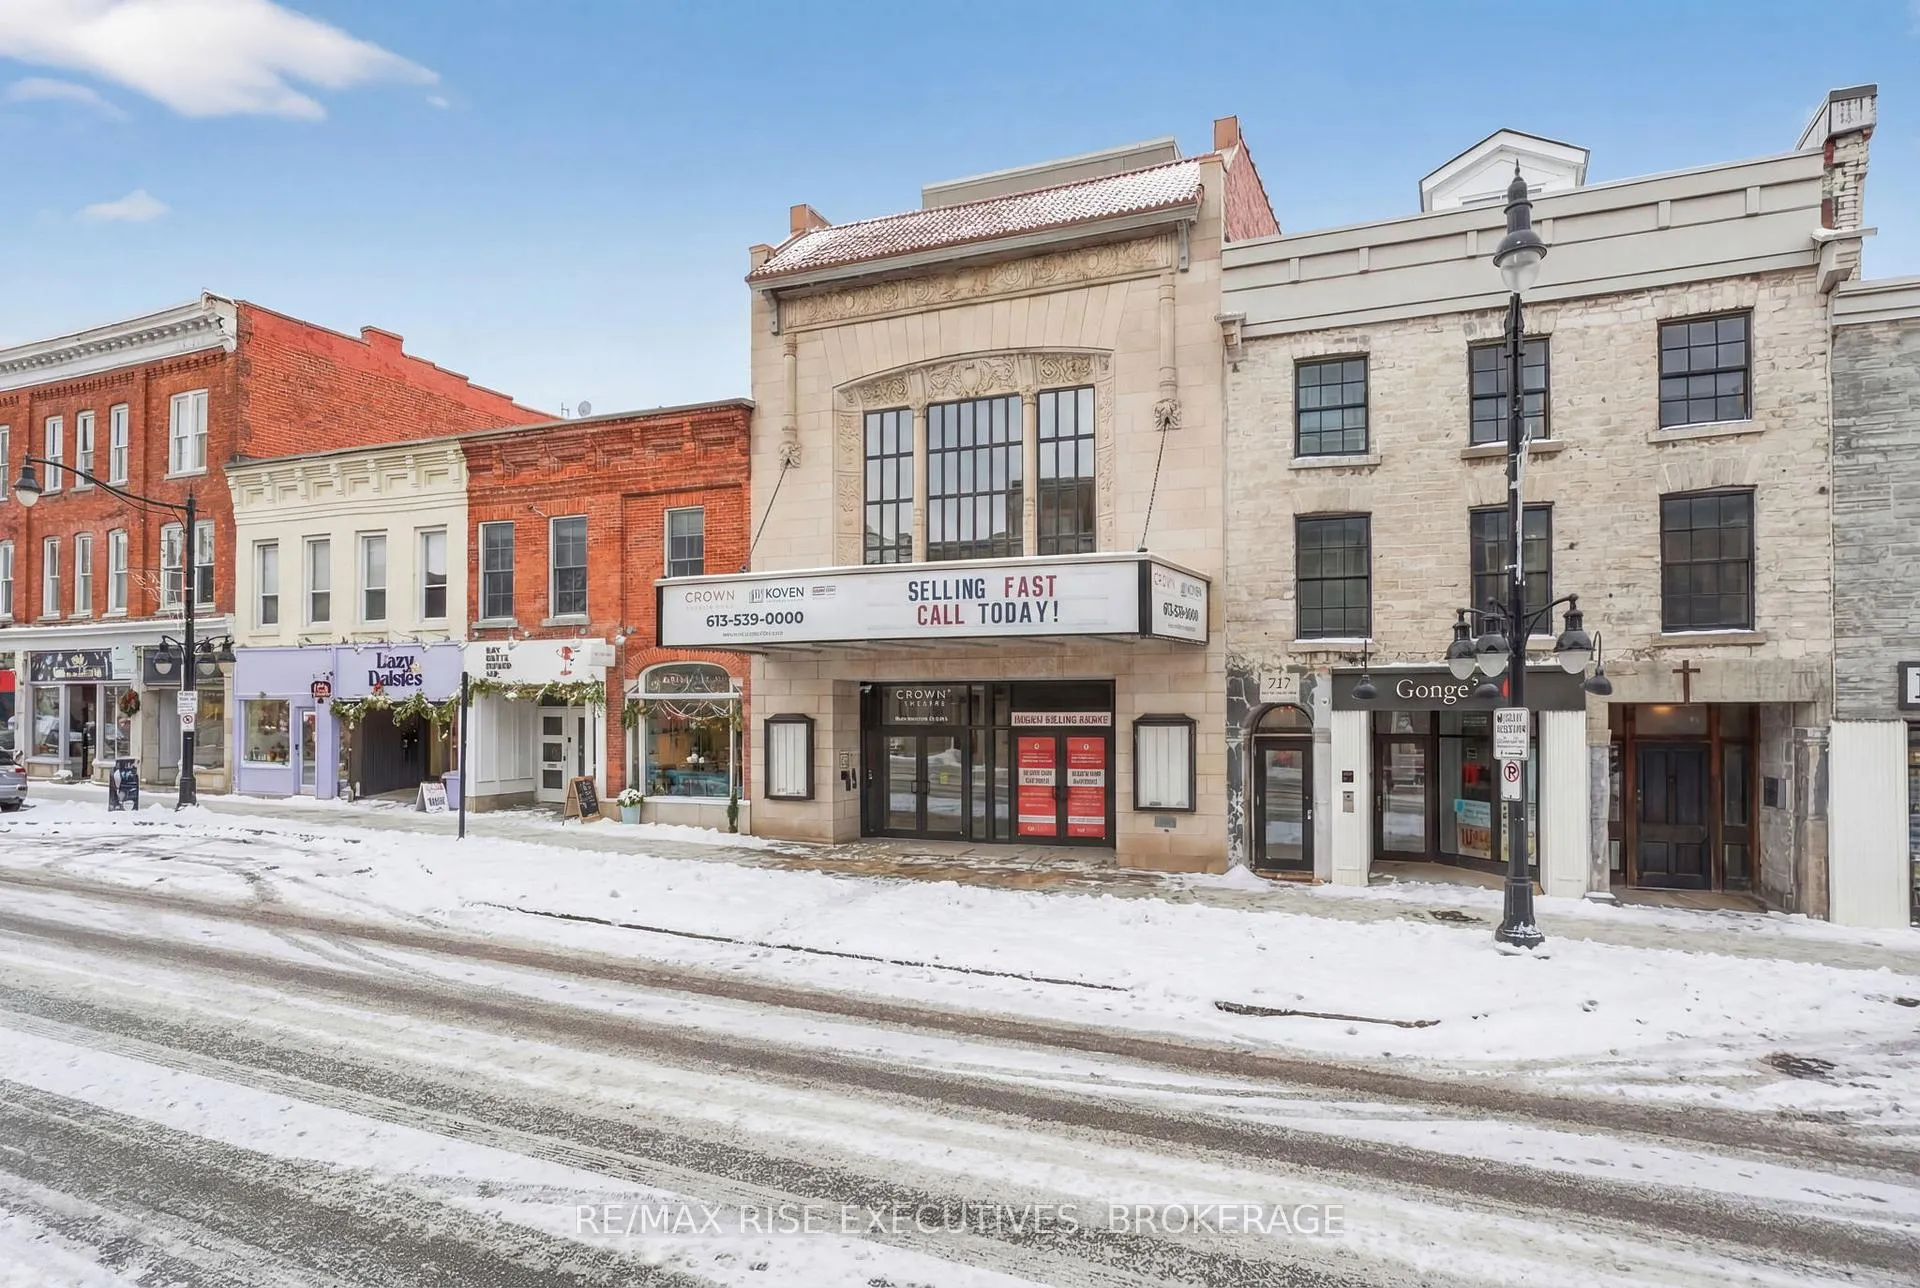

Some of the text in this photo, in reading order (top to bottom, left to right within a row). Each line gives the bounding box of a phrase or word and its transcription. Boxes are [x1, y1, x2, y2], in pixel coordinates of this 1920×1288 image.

[685, 590, 735, 603] CROWN
[765, 587, 804, 600] KOVEN
[908, 575, 1057, 601] SELLING FAST
[706, 611, 804, 628] 613-539-0000
[917, 600, 1059, 626] CALL TODAY!
[376, 652, 415, 673] Lazy
[368, 670, 423, 687] Daisies
[1268, 677, 1291, 689] 717
[896, 689, 946, 700] CROWN
[1396, 677, 1480, 705] Gonge'
